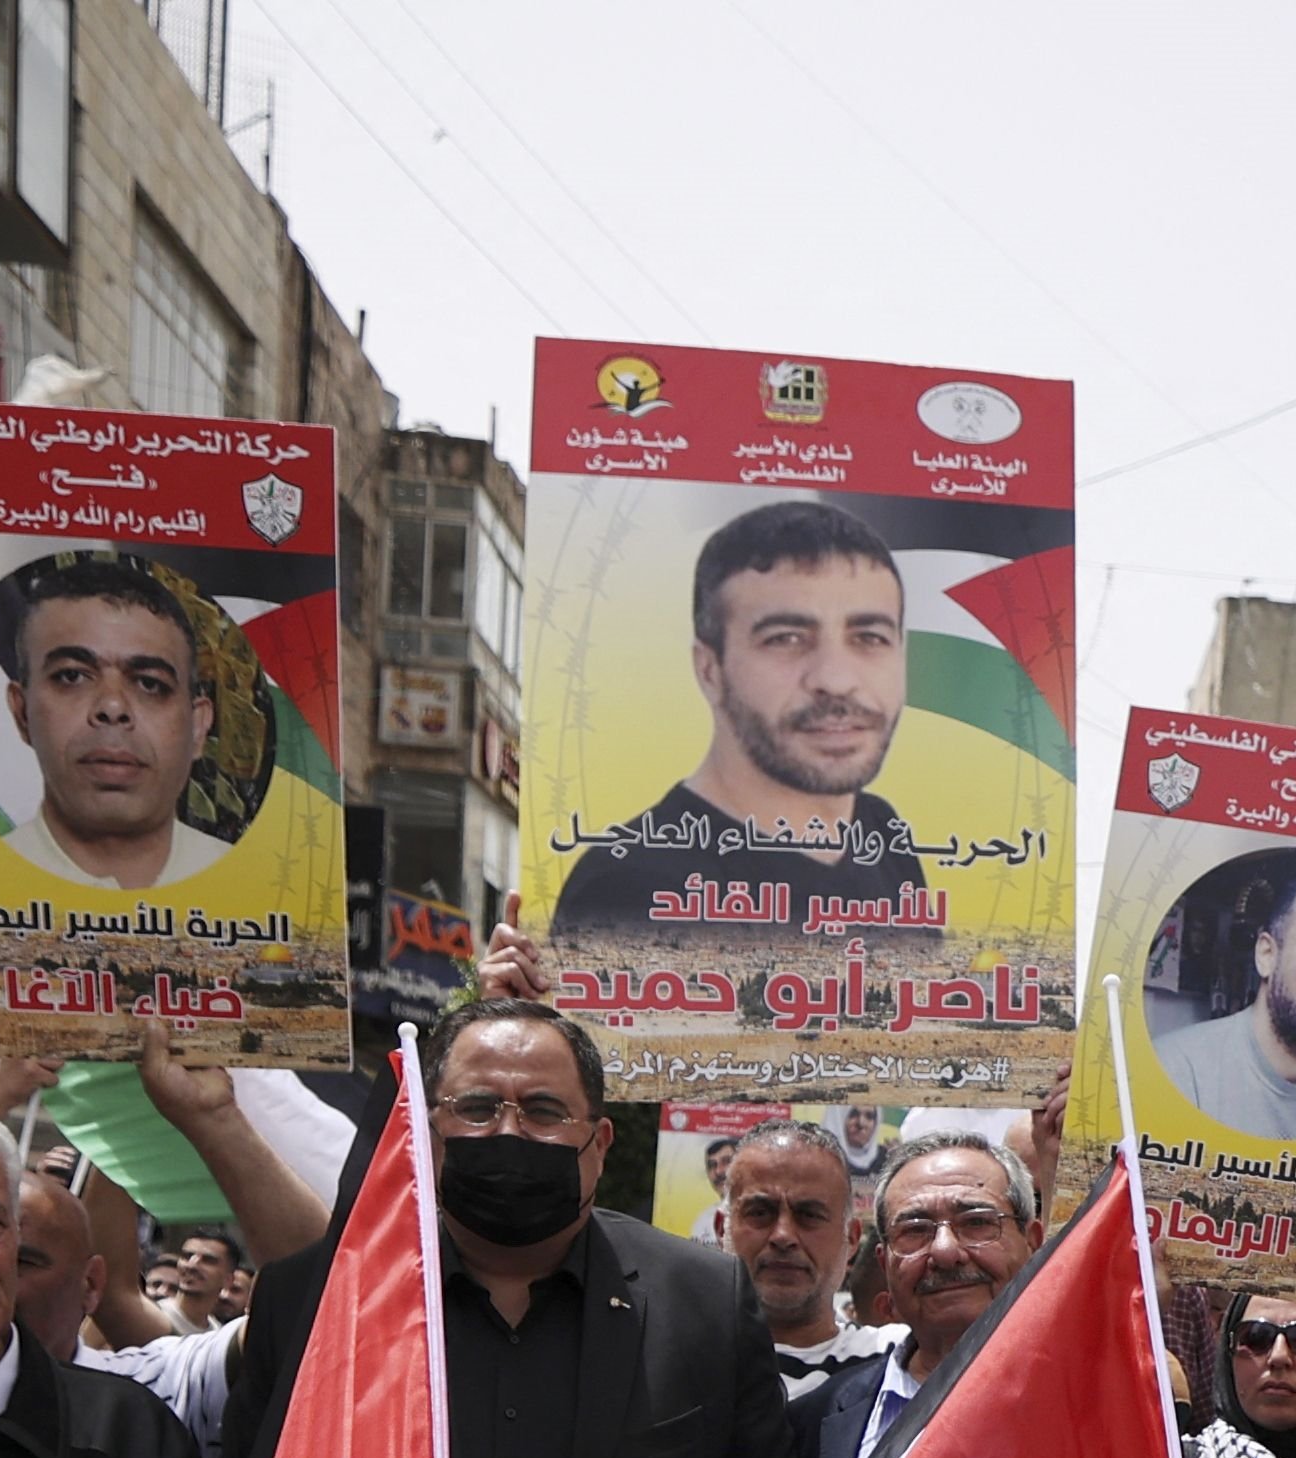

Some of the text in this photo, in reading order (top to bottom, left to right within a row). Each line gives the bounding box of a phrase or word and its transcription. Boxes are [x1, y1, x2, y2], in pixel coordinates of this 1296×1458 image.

[29, 419, 125, 455] الوطني
[133, 428, 232, 460] التحرير
[234, 432, 310, 466] حركة
[566, 426, 688, 453] هيئة شؤون
[734, 435, 853, 463] نادي الأسير
[585, 450, 668, 472] الأسرى
[740, 461, 846, 483] الفلسطيني
[913, 450, 967, 471] العليا
[930, 475, 1007, 496] للأسرى
[74, 493, 110, 526] الله
[114, 506, 146, 534] رام
[148, 509, 207, 537] إقليم
[1144, 720, 1268, 754] الفلسطيني
[1224, 798, 1291, 829] والبيرة
[549, 809, 1046, 868] الحرية والشفاء العاجل
[649, 874, 947, 934] للأسير القائد
[64, 901, 173, 941] للأسير
[185, 907, 289, 948] الحرية
[5, 966, 243, 1031] ضياء الآغا
[554, 938, 1041, 1033] ناصر أبو حميد
[668, 1048, 777, 1086] وستهزم
[1142, 1198, 1292, 1259] الريماو
